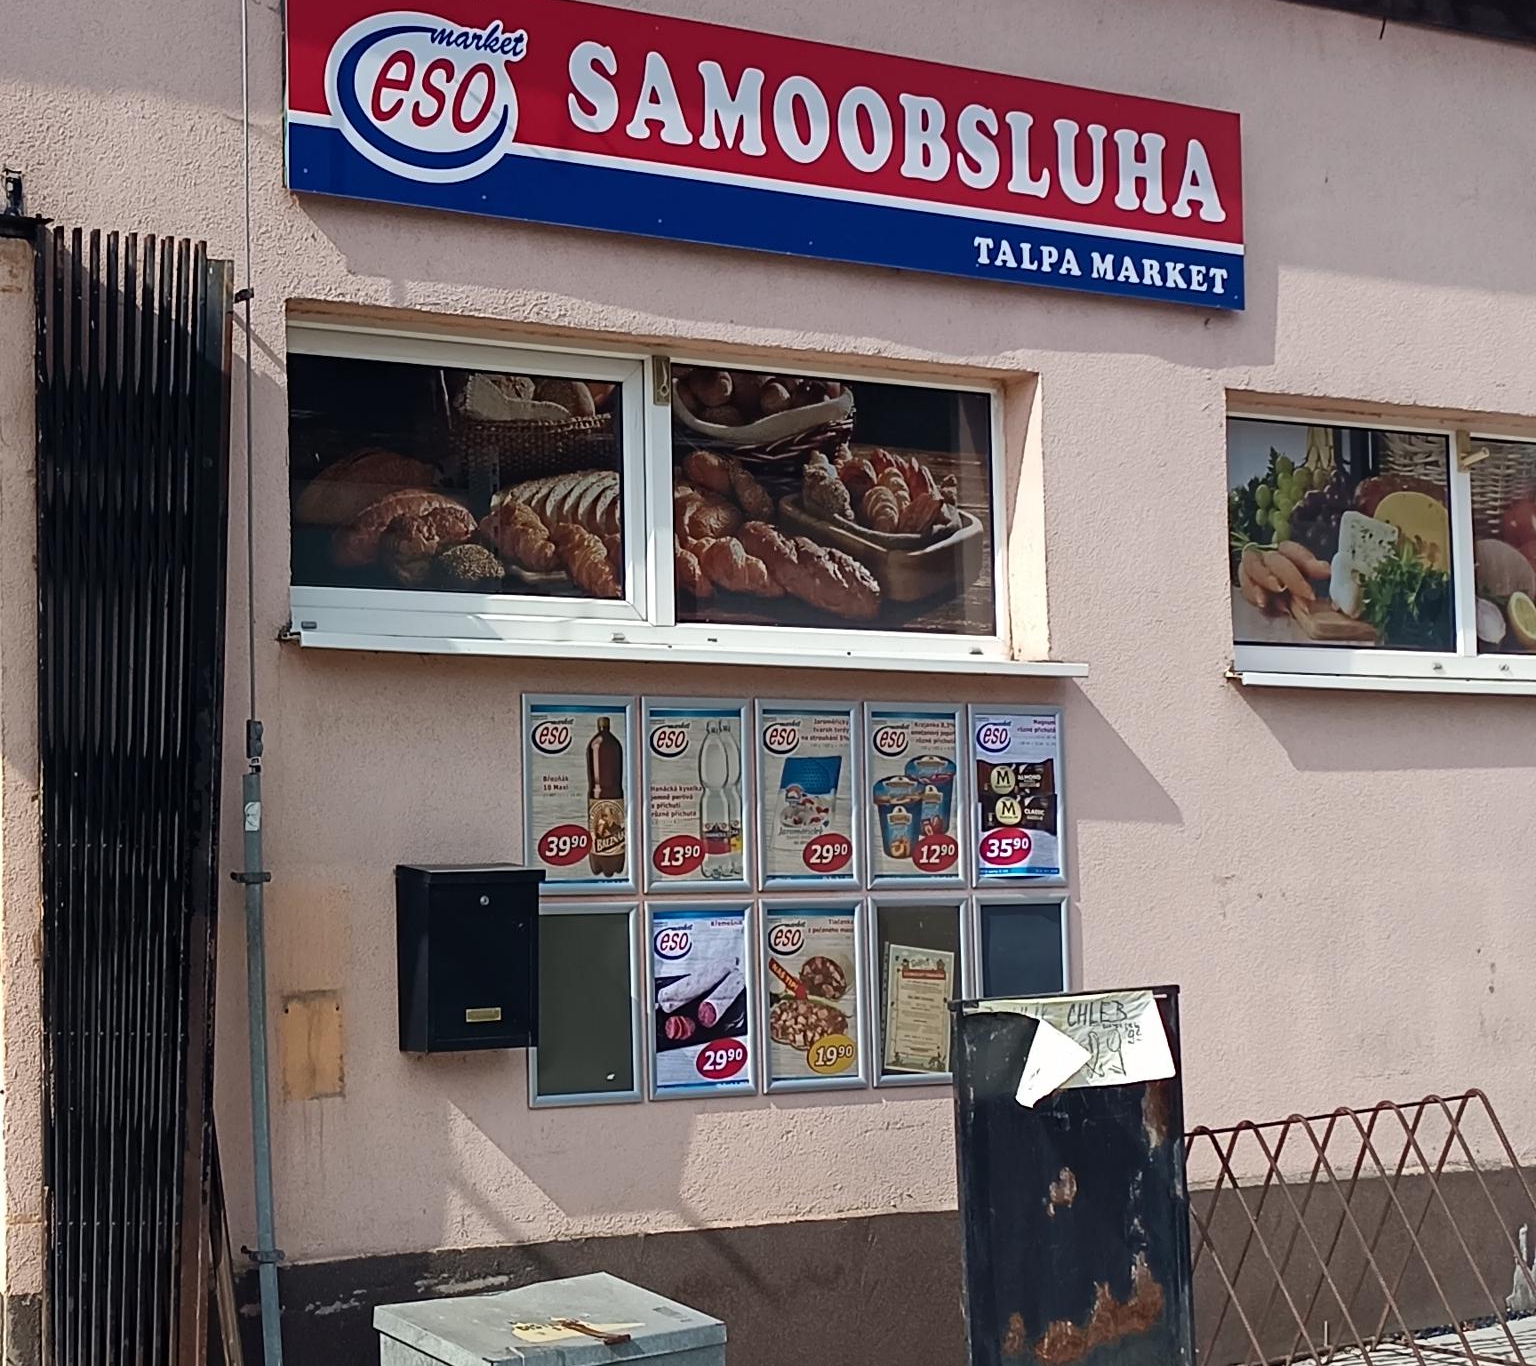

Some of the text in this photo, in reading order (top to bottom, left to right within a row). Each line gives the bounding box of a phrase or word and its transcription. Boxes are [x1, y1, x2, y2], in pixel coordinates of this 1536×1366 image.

[430, 23, 524, 56] market
[371, 49, 496, 133] eso
[567, 40, 1228, 223] SAMOOBSLUHA
[974, 236, 1228, 294] TALPA MARKET
[539, 726, 569, 745] eso
[657, 730, 685, 748] eso
[769, 728, 796, 745] eso
[880, 731, 906, 748] eso
[983, 727, 1008, 744] eso
[660, 933, 689, 951] eso
[774, 929, 801, 946] eso
